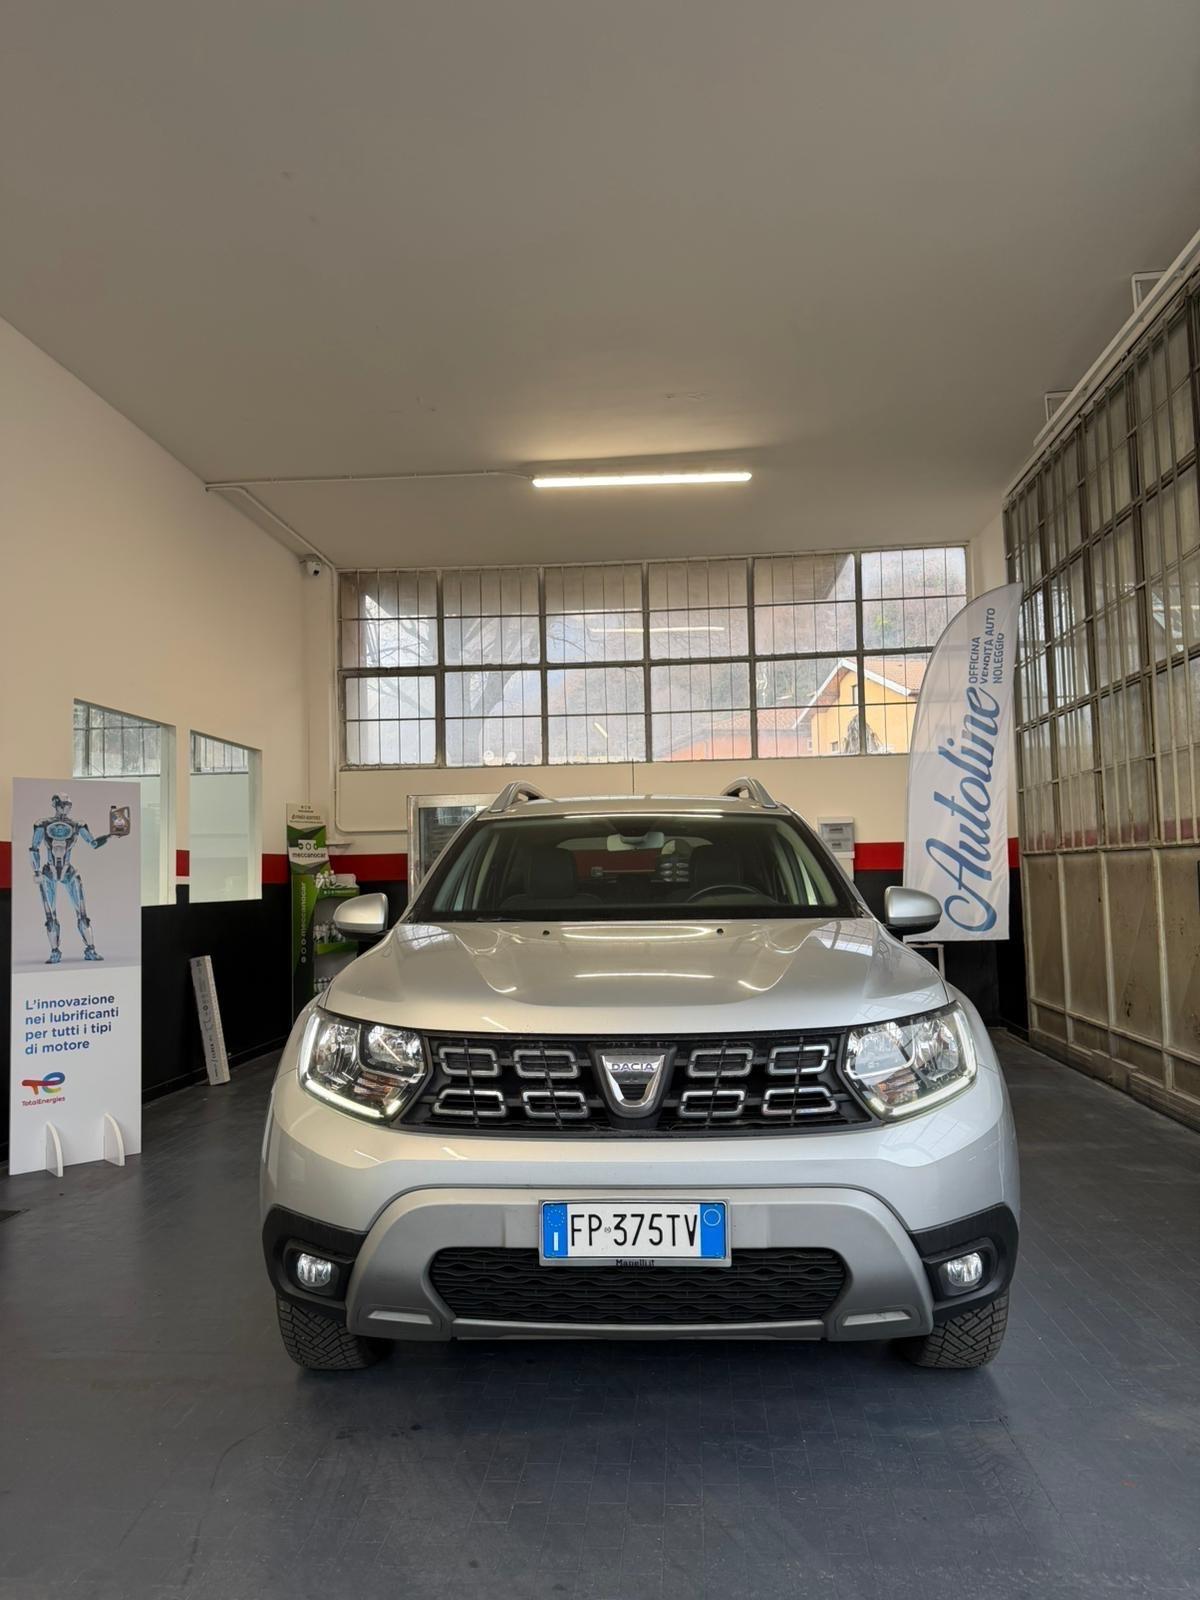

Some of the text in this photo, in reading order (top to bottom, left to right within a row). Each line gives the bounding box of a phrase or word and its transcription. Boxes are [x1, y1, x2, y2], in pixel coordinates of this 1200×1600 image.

[980, 607, 996, 684] VENDITA AUTO
[968, 637, 981, 684] OFFICINA
[992, 632, 1005, 684] NOLEGGIO
[926, 686, 1001, 933] Autoline
[25, 995, 115, 1010] L'innovazione
[25, 1006, 120, 1025] nei lubrificanti
[25, 1029, 48, 1042] per
[51, 1025, 80, 1038] tutti
[91, 1021, 112, 1035] tipi
[25, 1040, 90, 1055] di motore
[611, 1063, 654, 1071] DACIA
[21, 1096, 66, 1106] TotalEnergies
